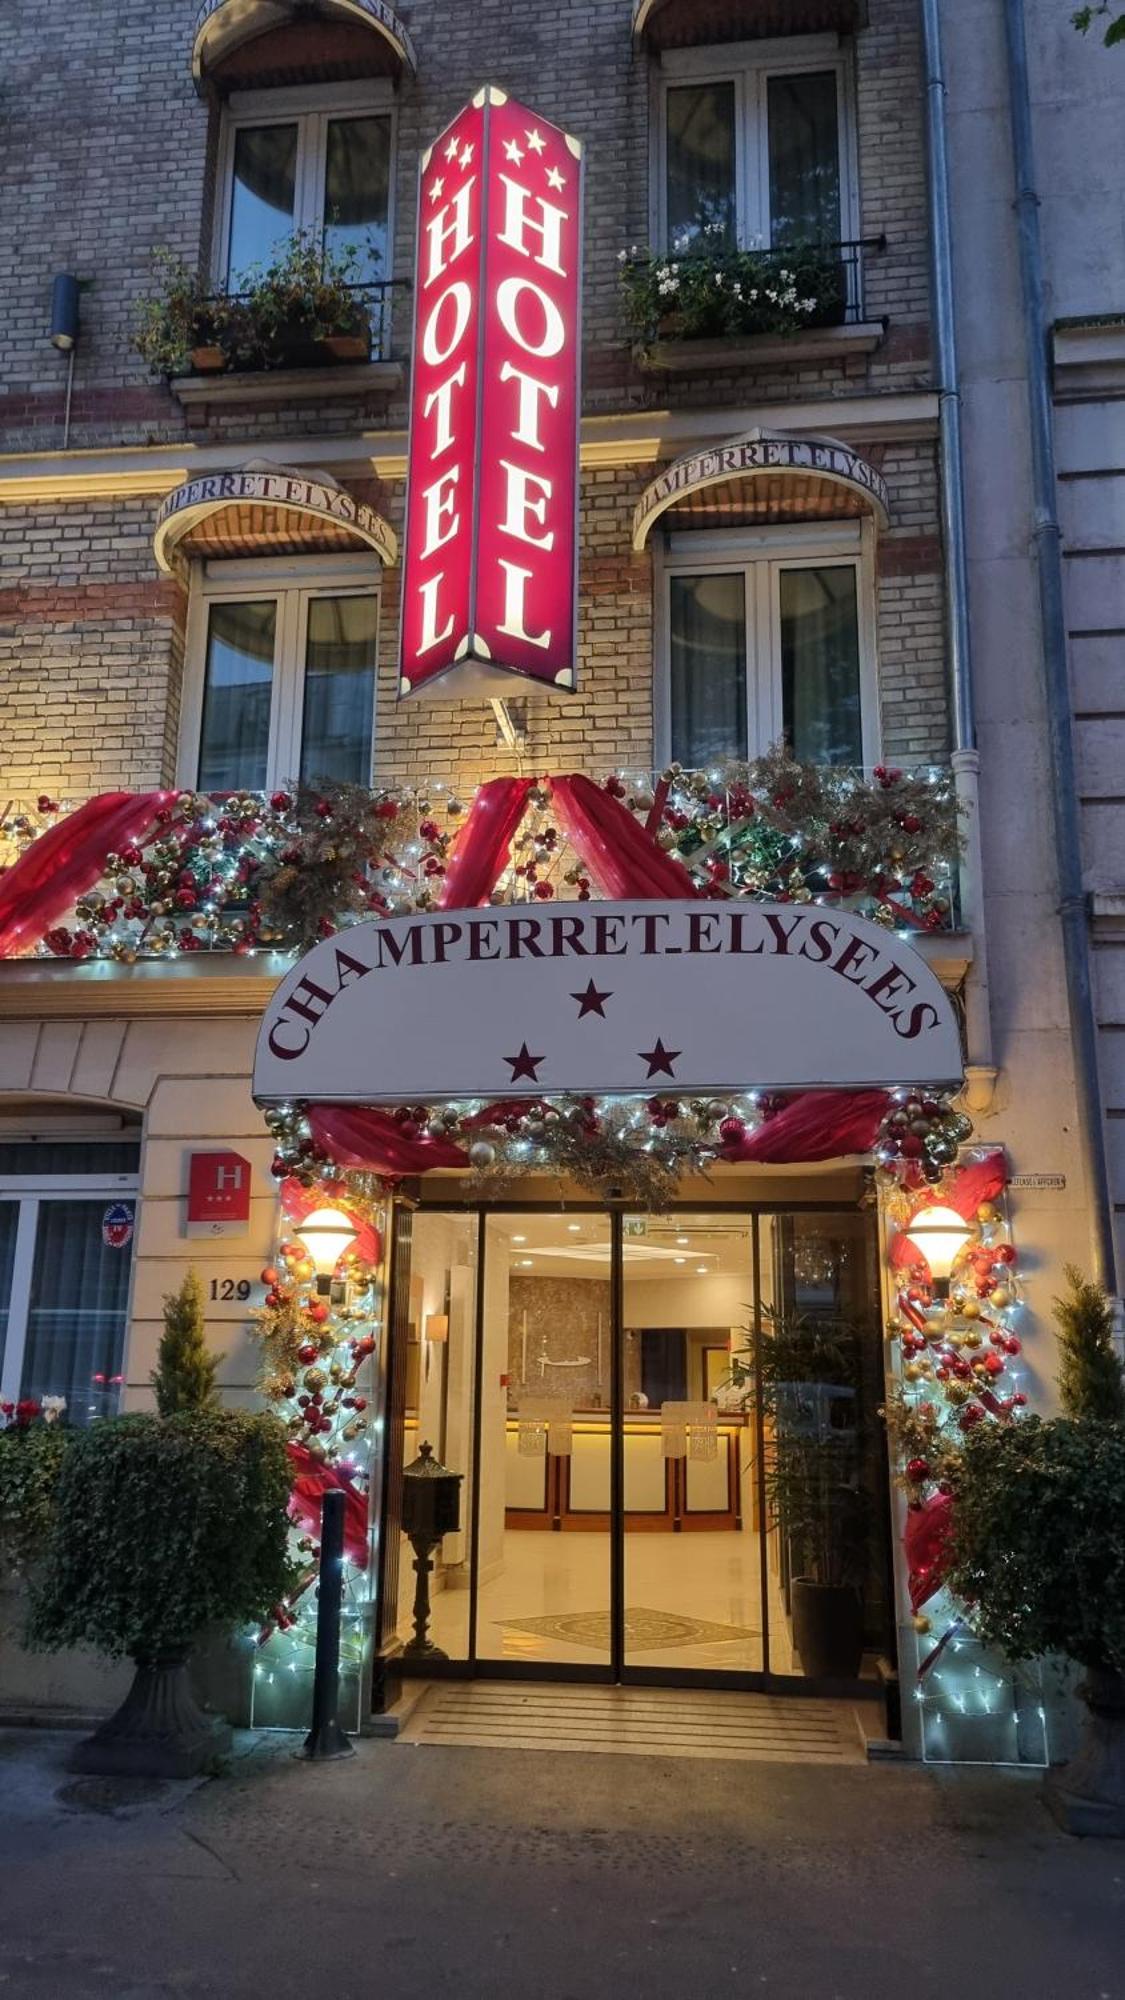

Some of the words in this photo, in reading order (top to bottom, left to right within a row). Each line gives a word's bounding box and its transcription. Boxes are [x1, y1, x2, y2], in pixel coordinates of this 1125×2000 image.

[415, 175, 476, 657] HOTEL
[496, 173, 569, 650] HOTEL
[210, 1278, 251, 1301] 129
[217, 1165, 242, 1190] H
